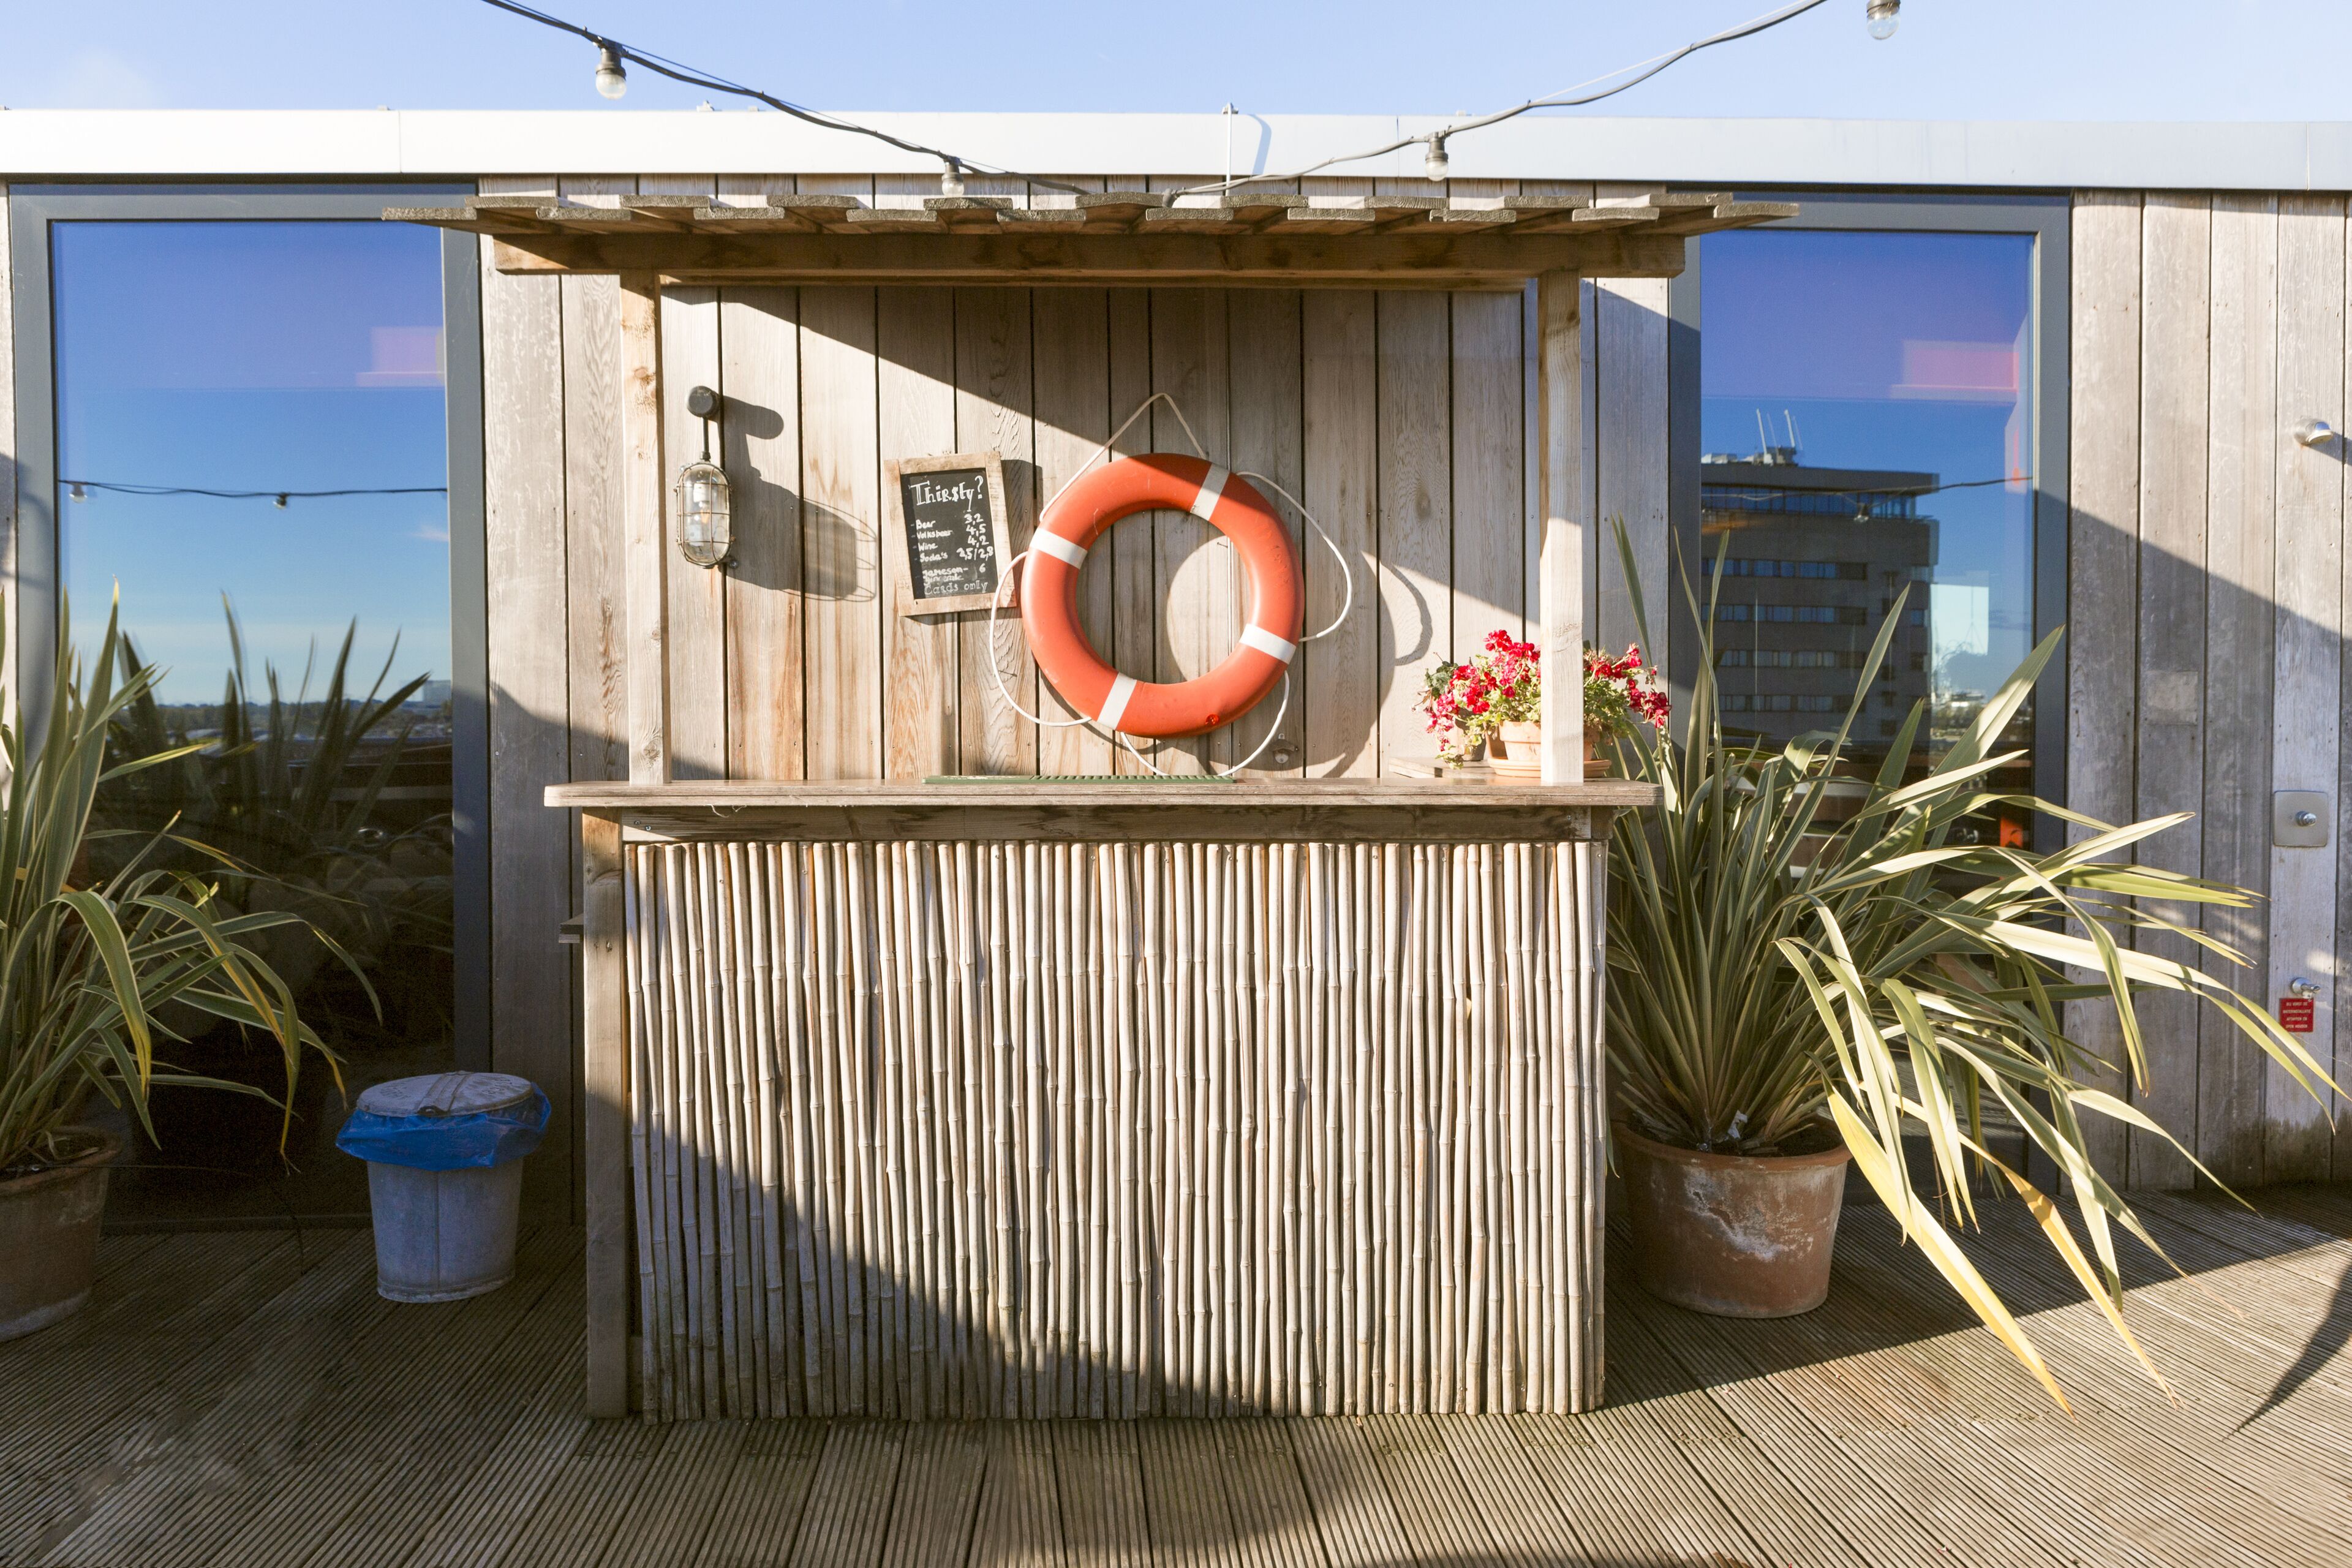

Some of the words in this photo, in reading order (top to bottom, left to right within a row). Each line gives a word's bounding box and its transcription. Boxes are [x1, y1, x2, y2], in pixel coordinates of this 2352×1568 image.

[964, 513, 984, 525] 3,2
[966, 524, 986, 537] 4,5
[918, 543, 938, 552] Wine
[968, 535, 989, 548] 4,2
[920, 552, 948, 562] Soda's
[979, 563, 986, 573] 6
[964, 580, 989, 594] only
